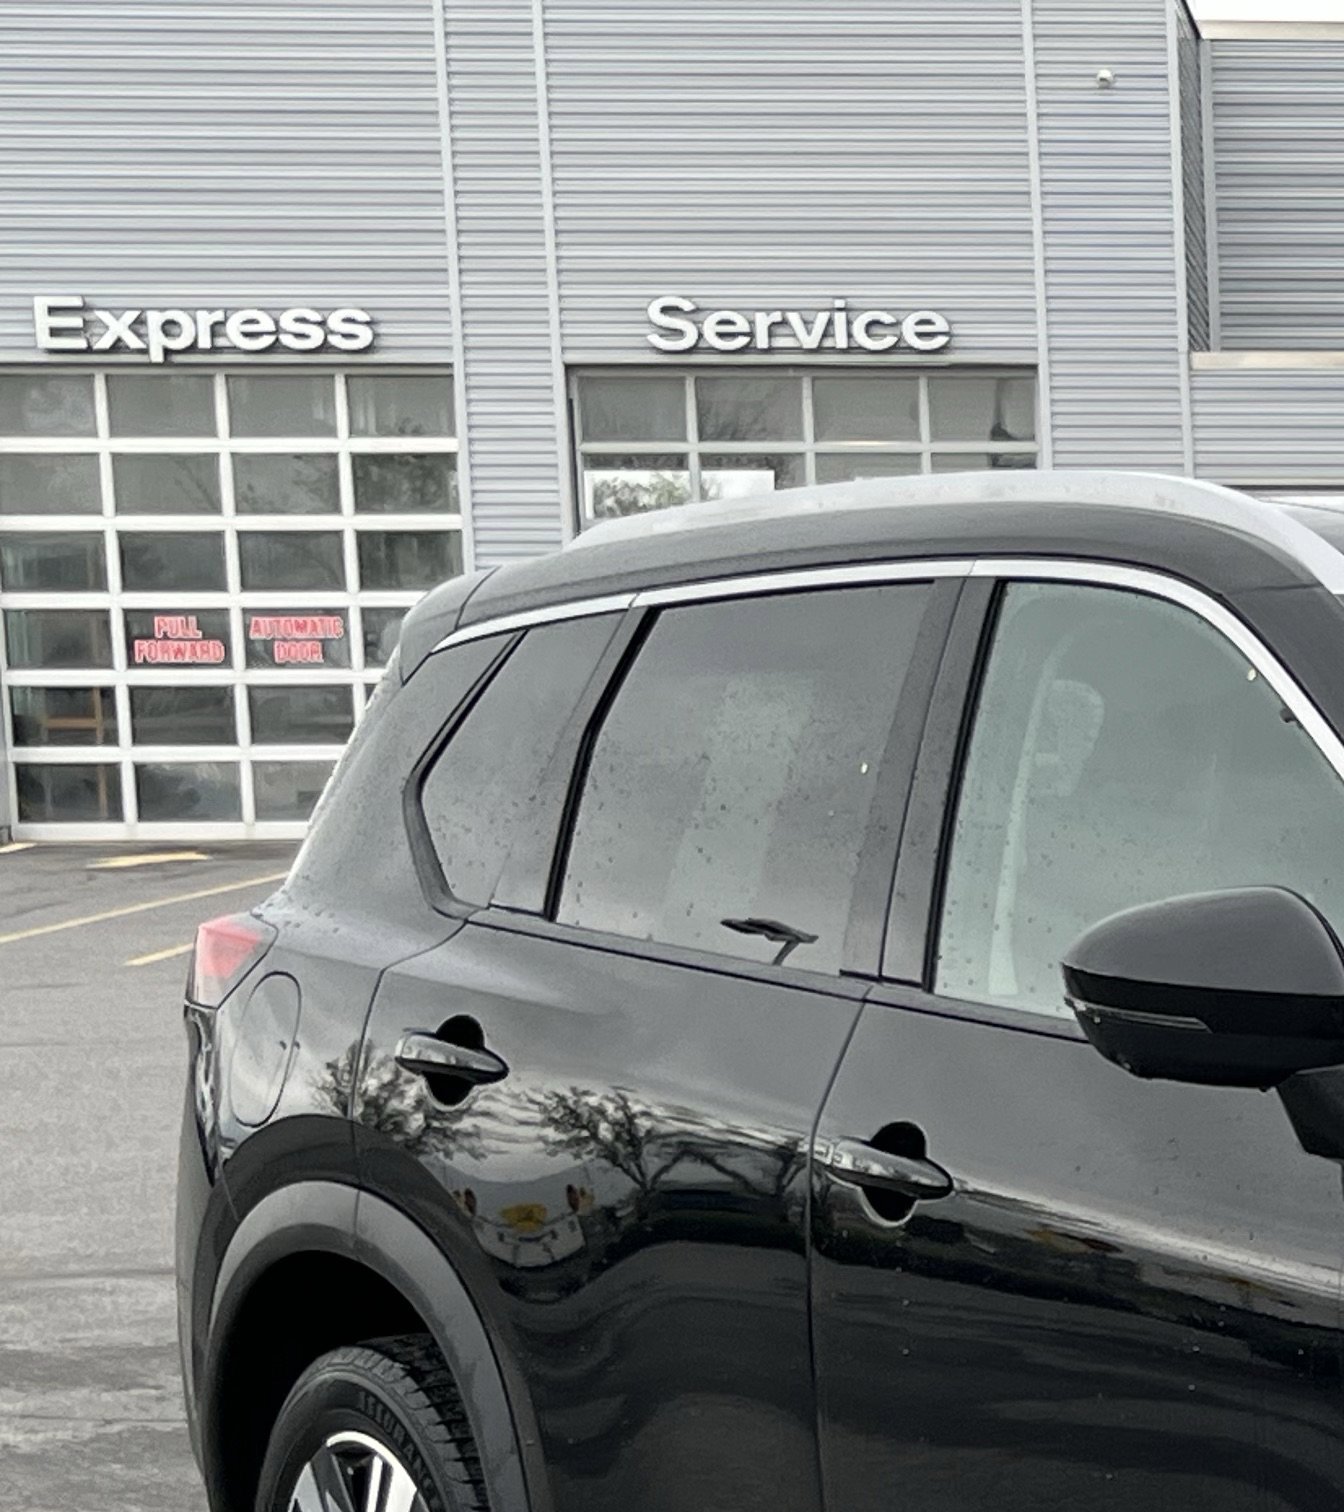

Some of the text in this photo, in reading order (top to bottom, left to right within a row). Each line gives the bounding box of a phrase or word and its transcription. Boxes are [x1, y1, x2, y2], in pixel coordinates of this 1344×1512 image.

[33, 296, 375, 363] Express
[646, 296, 950, 351] Service
[154, 616, 202, 638] PULL
[249, 616, 344, 639] AUTOMATIC
[134, 640, 225, 663] FORWARD
[274, 641, 324, 663] DOOR
